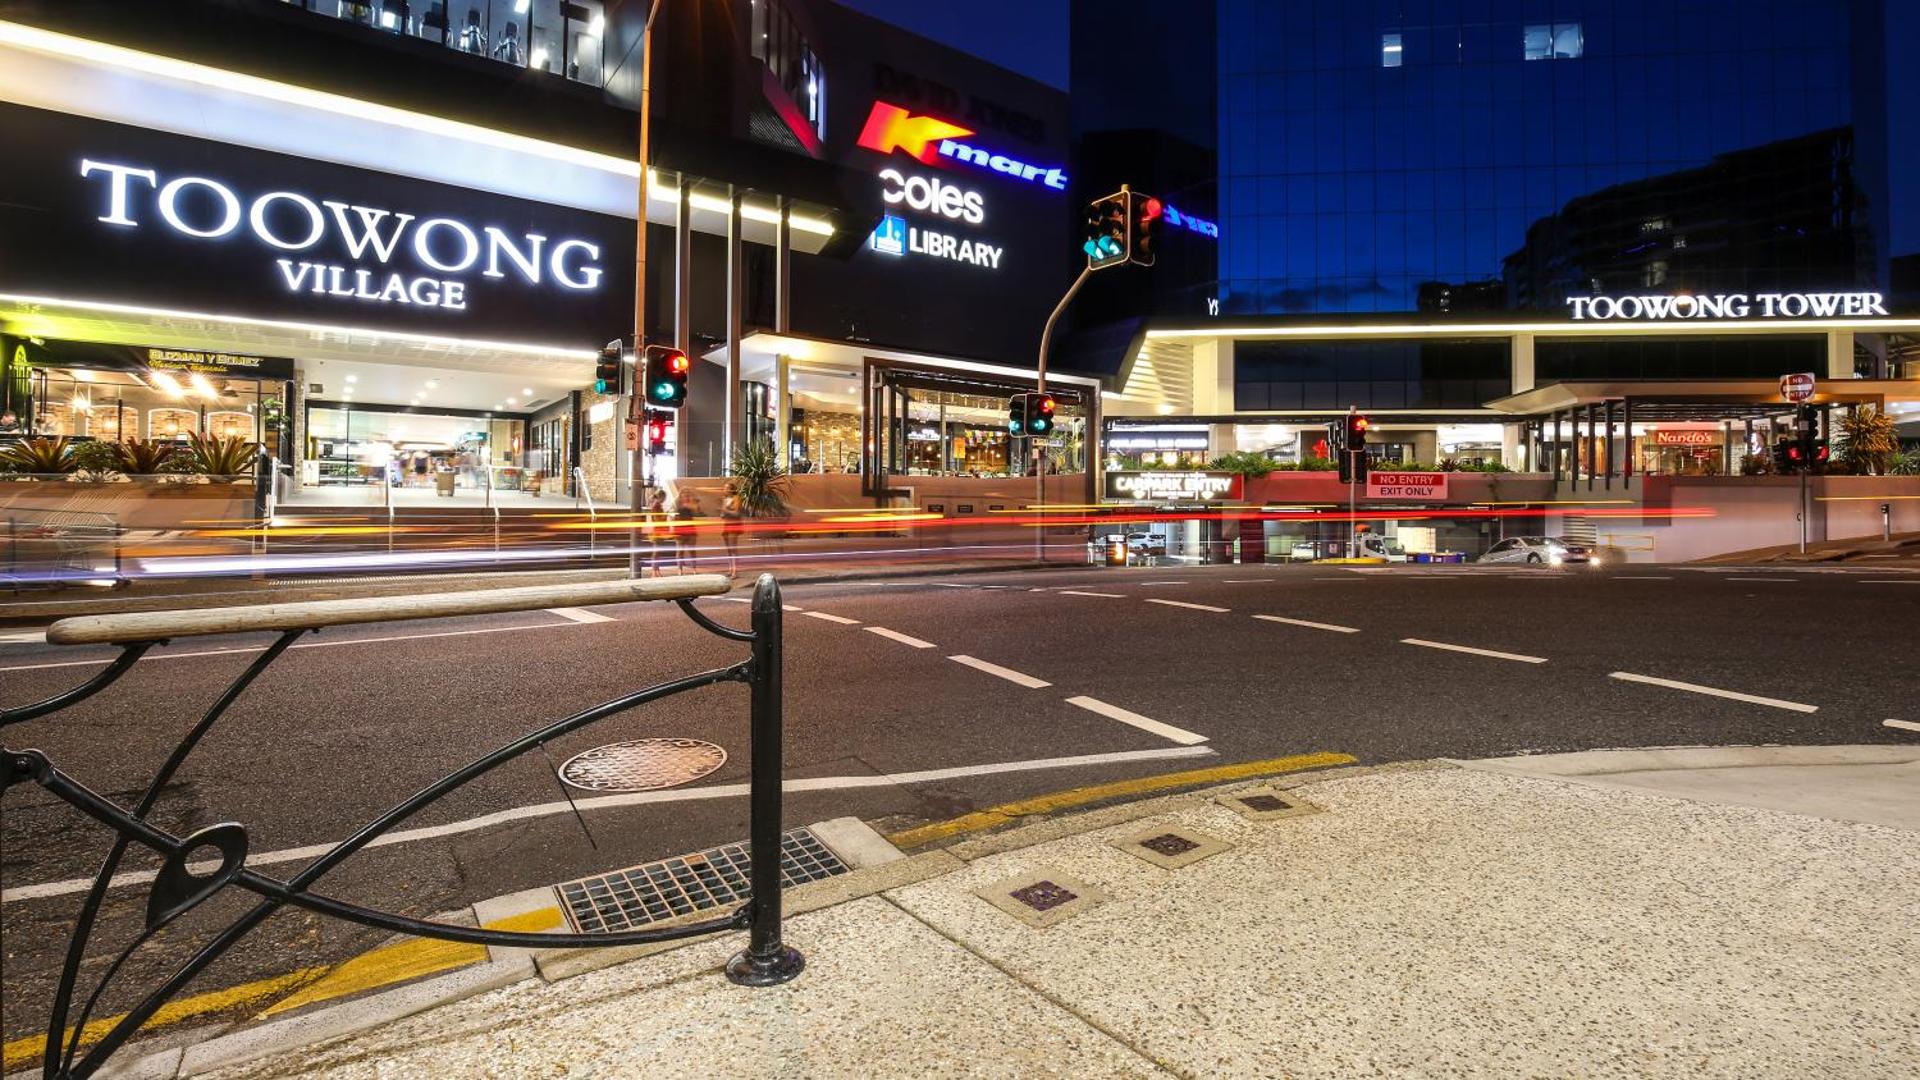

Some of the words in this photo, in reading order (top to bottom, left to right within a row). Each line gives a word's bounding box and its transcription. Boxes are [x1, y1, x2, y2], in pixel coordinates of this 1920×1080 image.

[879, 169, 984, 223] coles
[80, 158, 603, 290] TOOWONG
[908, 227, 1003, 269] LIBRARY
[276, 258, 467, 310] VILLAGE
[1566, 294, 1750, 319] TOOWONG
[1755, 292, 1890, 317] TOWER
[1792, 376, 1803, 384] NO
[1658, 431, 1712, 443] Nando's
[1380, 475, 1396, 484] NO
[1399, 475, 1434, 485] ENTRY
[1380, 486, 1402, 496] EXIT
[1404, 486, 1434, 496] ONLY
